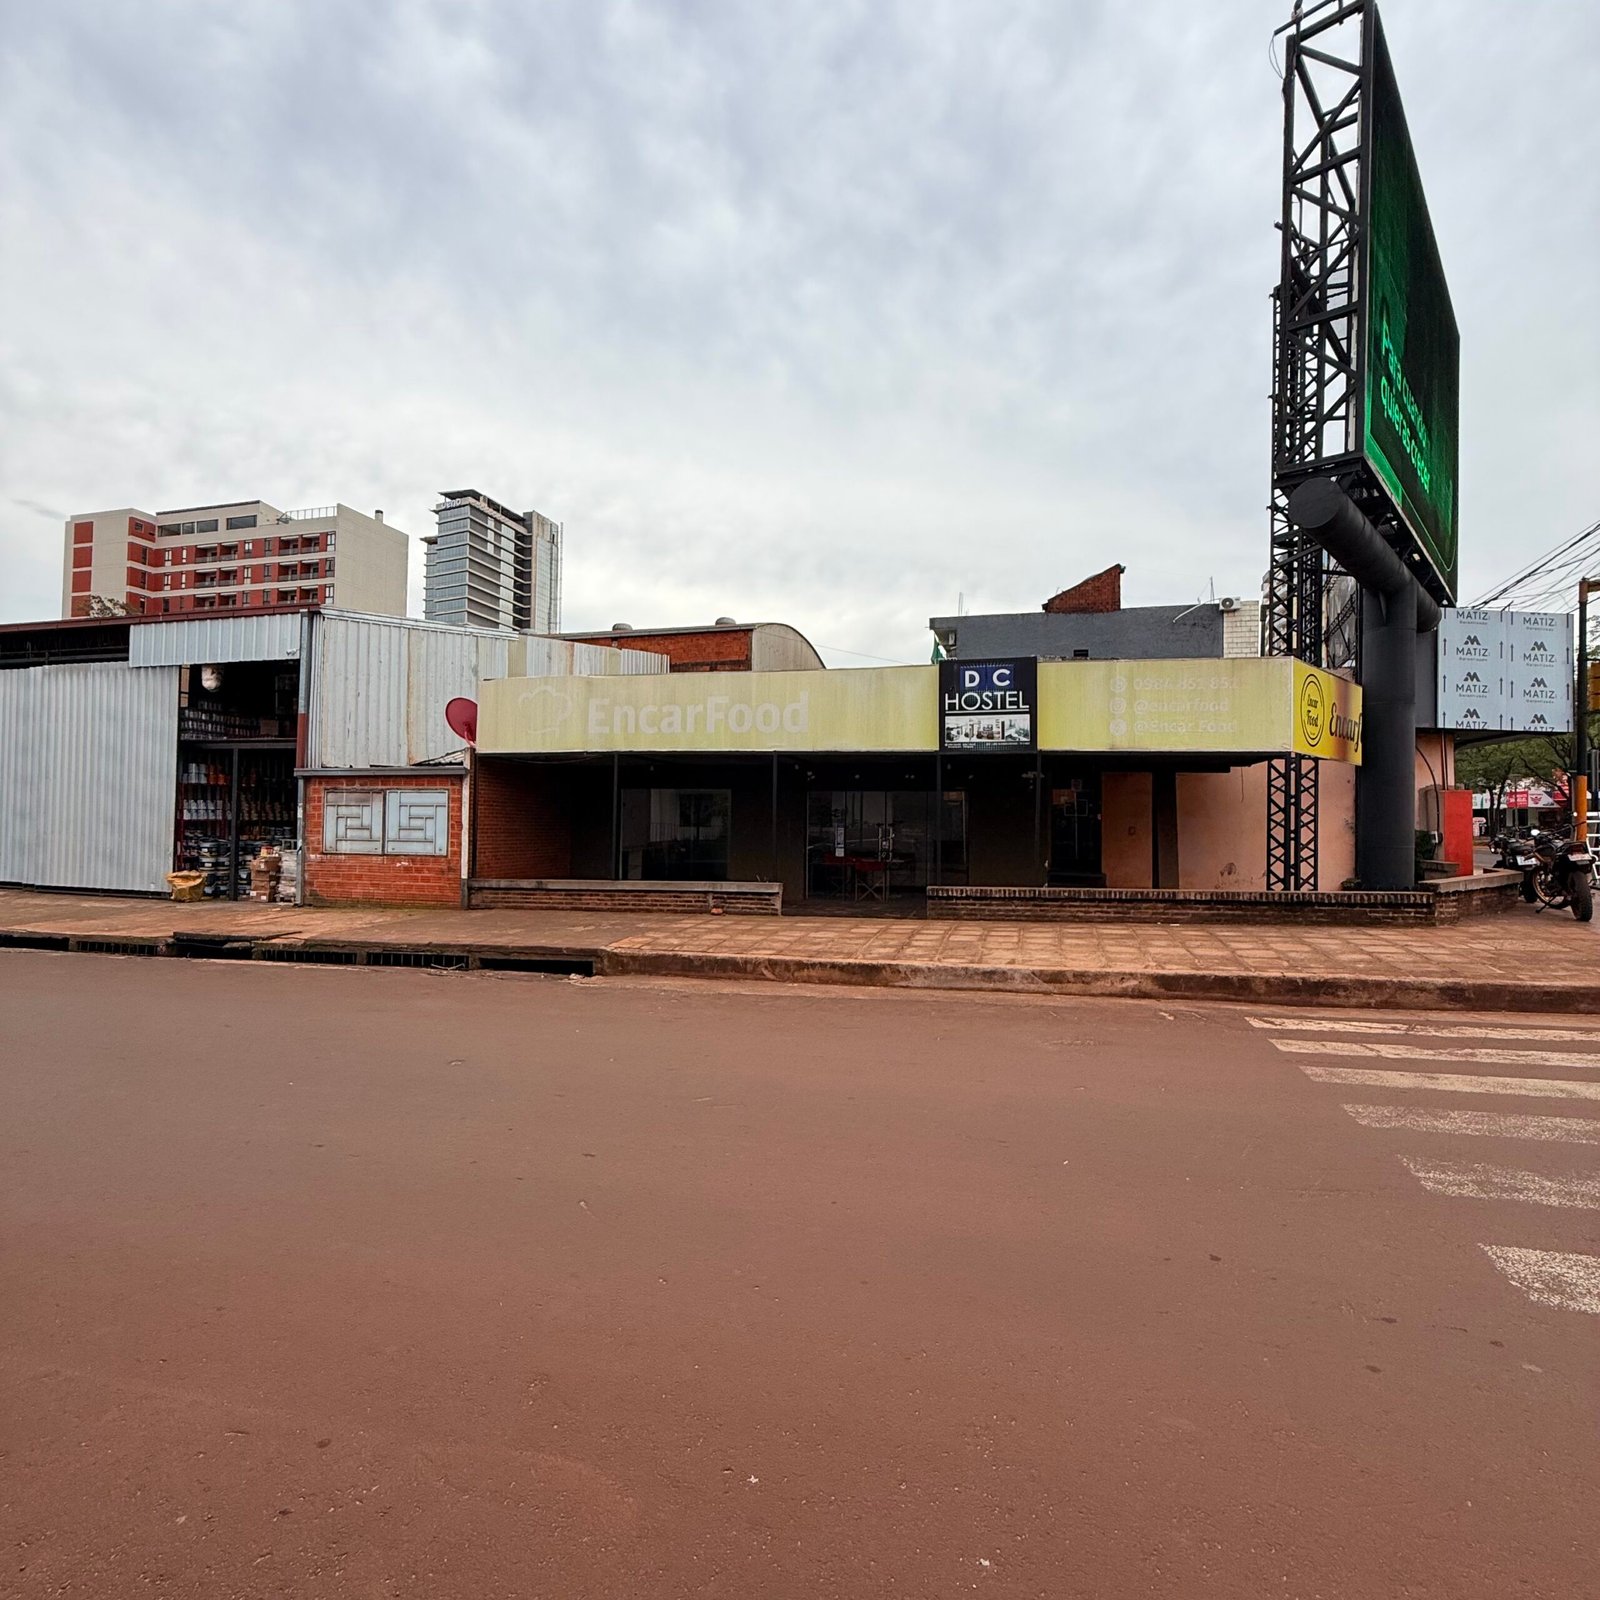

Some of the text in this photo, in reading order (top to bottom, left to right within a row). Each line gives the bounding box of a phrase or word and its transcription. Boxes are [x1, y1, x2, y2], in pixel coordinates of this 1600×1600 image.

[1456, 611, 1488, 620] MATIZ
[1523, 617, 1555, 627] MATIZ
[1456, 647, 1488, 657] MATIZ
[1523, 653, 1555, 663] MATIZ
[1456, 684, 1488, 693] MATIZ
[1523, 689, 1555, 699] MATIZ
[945, 690, 1030, 710] HOSTEL
[587, 688, 809, 735] EncarFood
[1456, 720, 1488, 729] MATIZ
